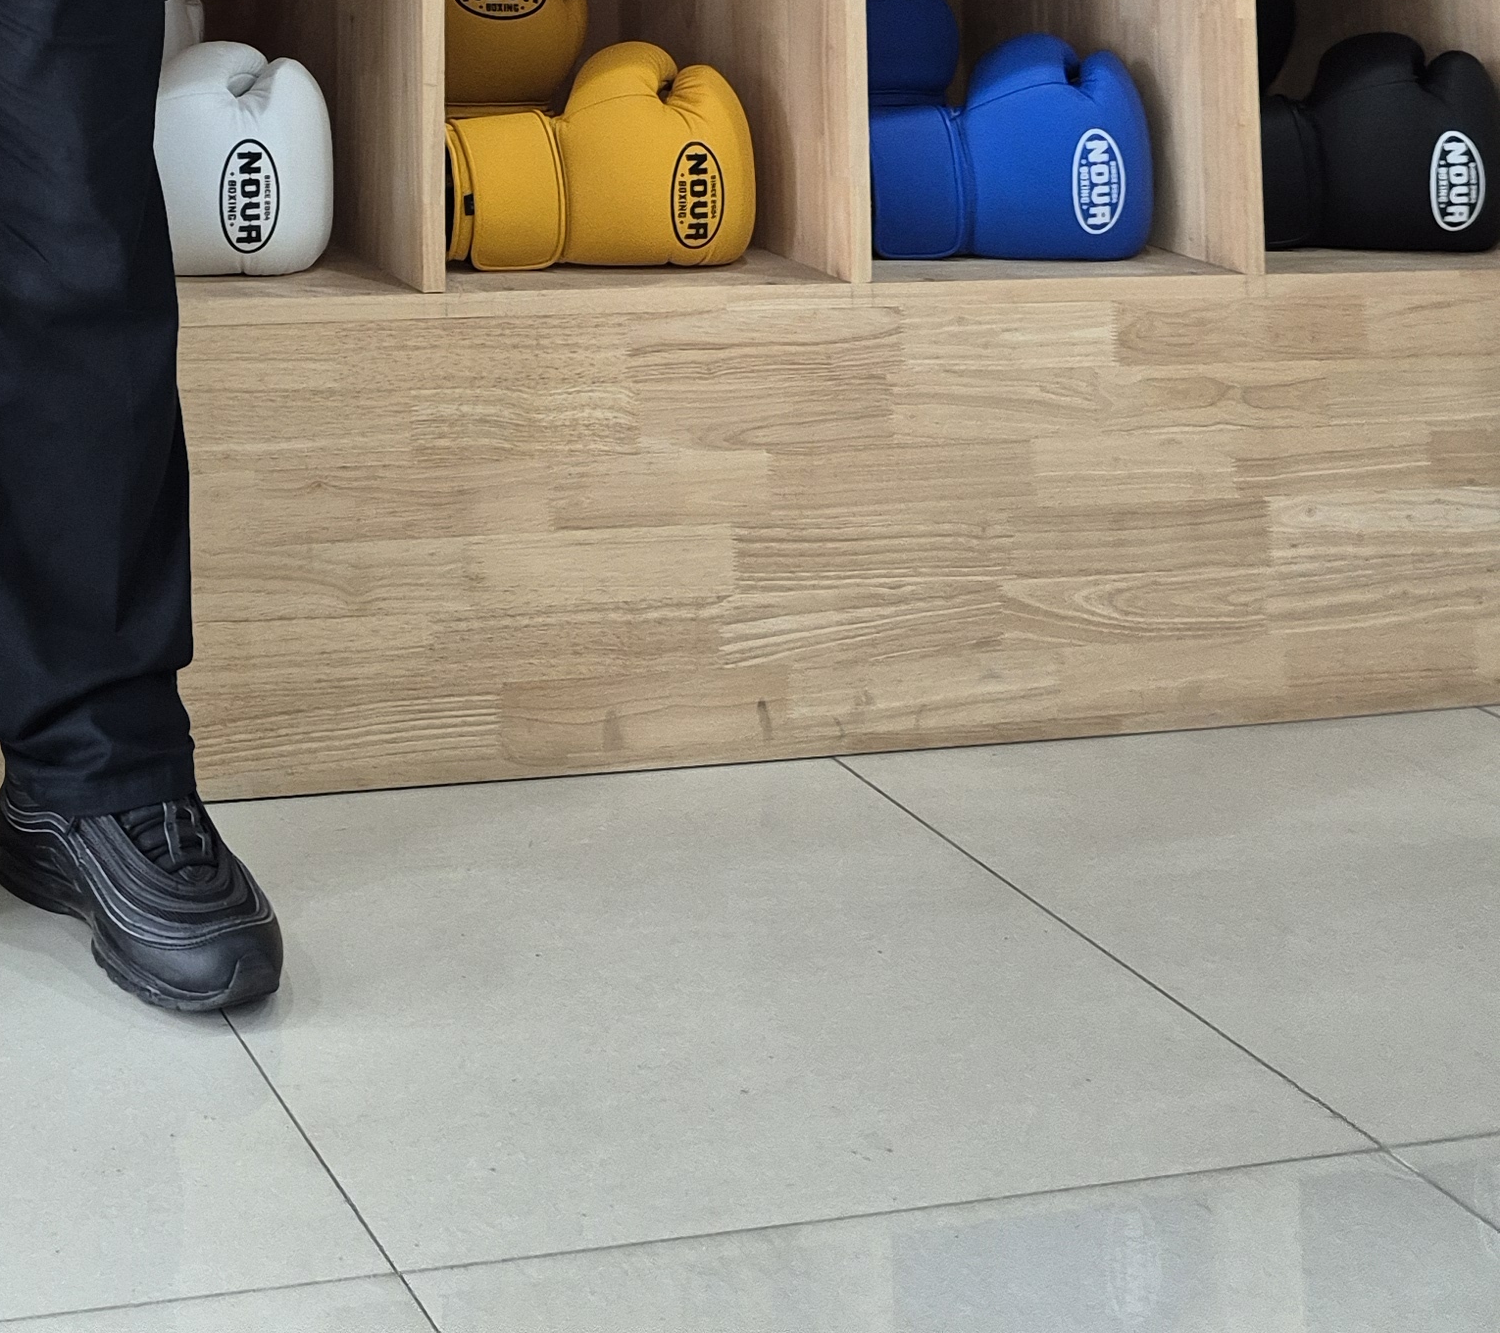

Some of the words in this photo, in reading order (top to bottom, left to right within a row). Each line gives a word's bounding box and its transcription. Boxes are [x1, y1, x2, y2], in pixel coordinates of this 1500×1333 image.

[485, 3, 520, 13] BOXING
[227, 179, 237, 221] BOXING
[677, 180, 688, 219] BOXING
